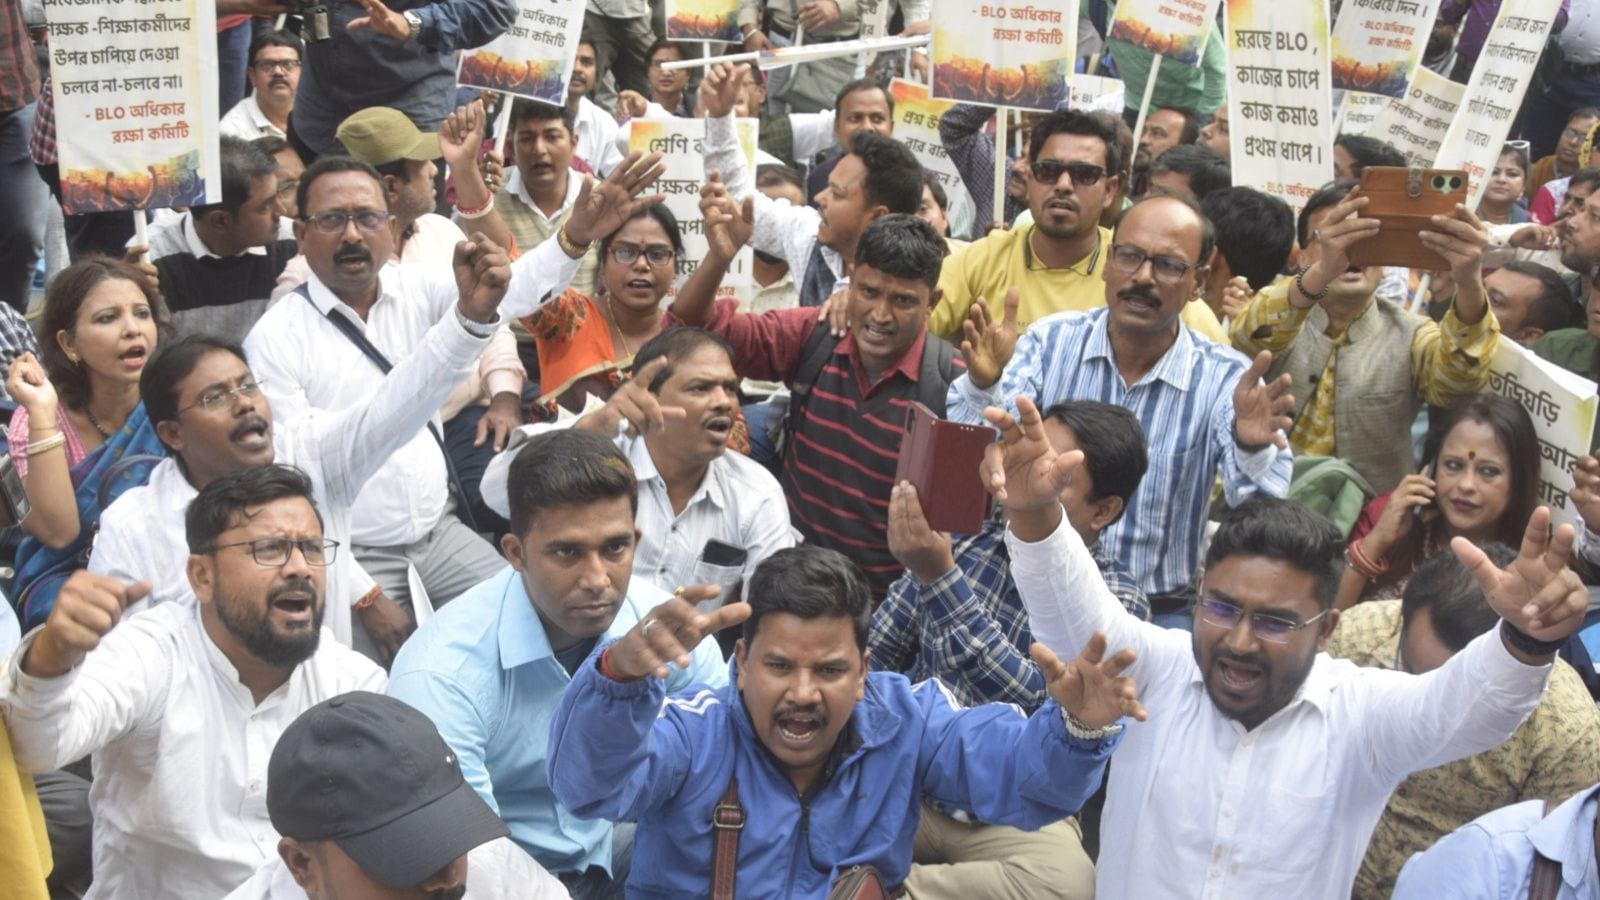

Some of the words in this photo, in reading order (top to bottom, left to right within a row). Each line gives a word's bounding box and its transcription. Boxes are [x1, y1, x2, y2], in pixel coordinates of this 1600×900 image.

[522, 8, 568, 28] অধিকার
[981, 6, 1007, 19] BLO
[1010, 5, 1063, 24] অধিকার
[1395, 1, 1419, 16] দিন
[46, 21, 88, 36] ক্ষক
[992, 28, 1021, 41] রক্ষা
[1024, 28, 1063, 44] কমিটি
[531, 30, 566, 48] কমিটি
[1235, 30, 1272, 50] মরছে
[1276, 32, 1308, 51] BLO
[55, 48, 88, 65] উপর
[91, 46, 136, 64] চাপিয়ে
[140, 46, 180, 63] দেওয়া
[1236, 65, 1282, 87] কাজের
[1286, 68, 1320, 90] চাপে
[61, 81, 99, 95] চলবে
[1409, 86, 1423, 98] LO
[95, 106, 125, 121] BLO
[129, 100, 186, 118] অধিকার
[1240, 101, 1273, 122] কাজ
[1276, 106, 1319, 127] কমাও
[112, 128, 144, 144] রক্ষা
[148, 121, 190, 140] কমিটি
[1245, 135, 1277, 157] প্রথম
[1280, 140, 1312, 163] ধাপে
[1286, 182, 1318, 197] অধিক
